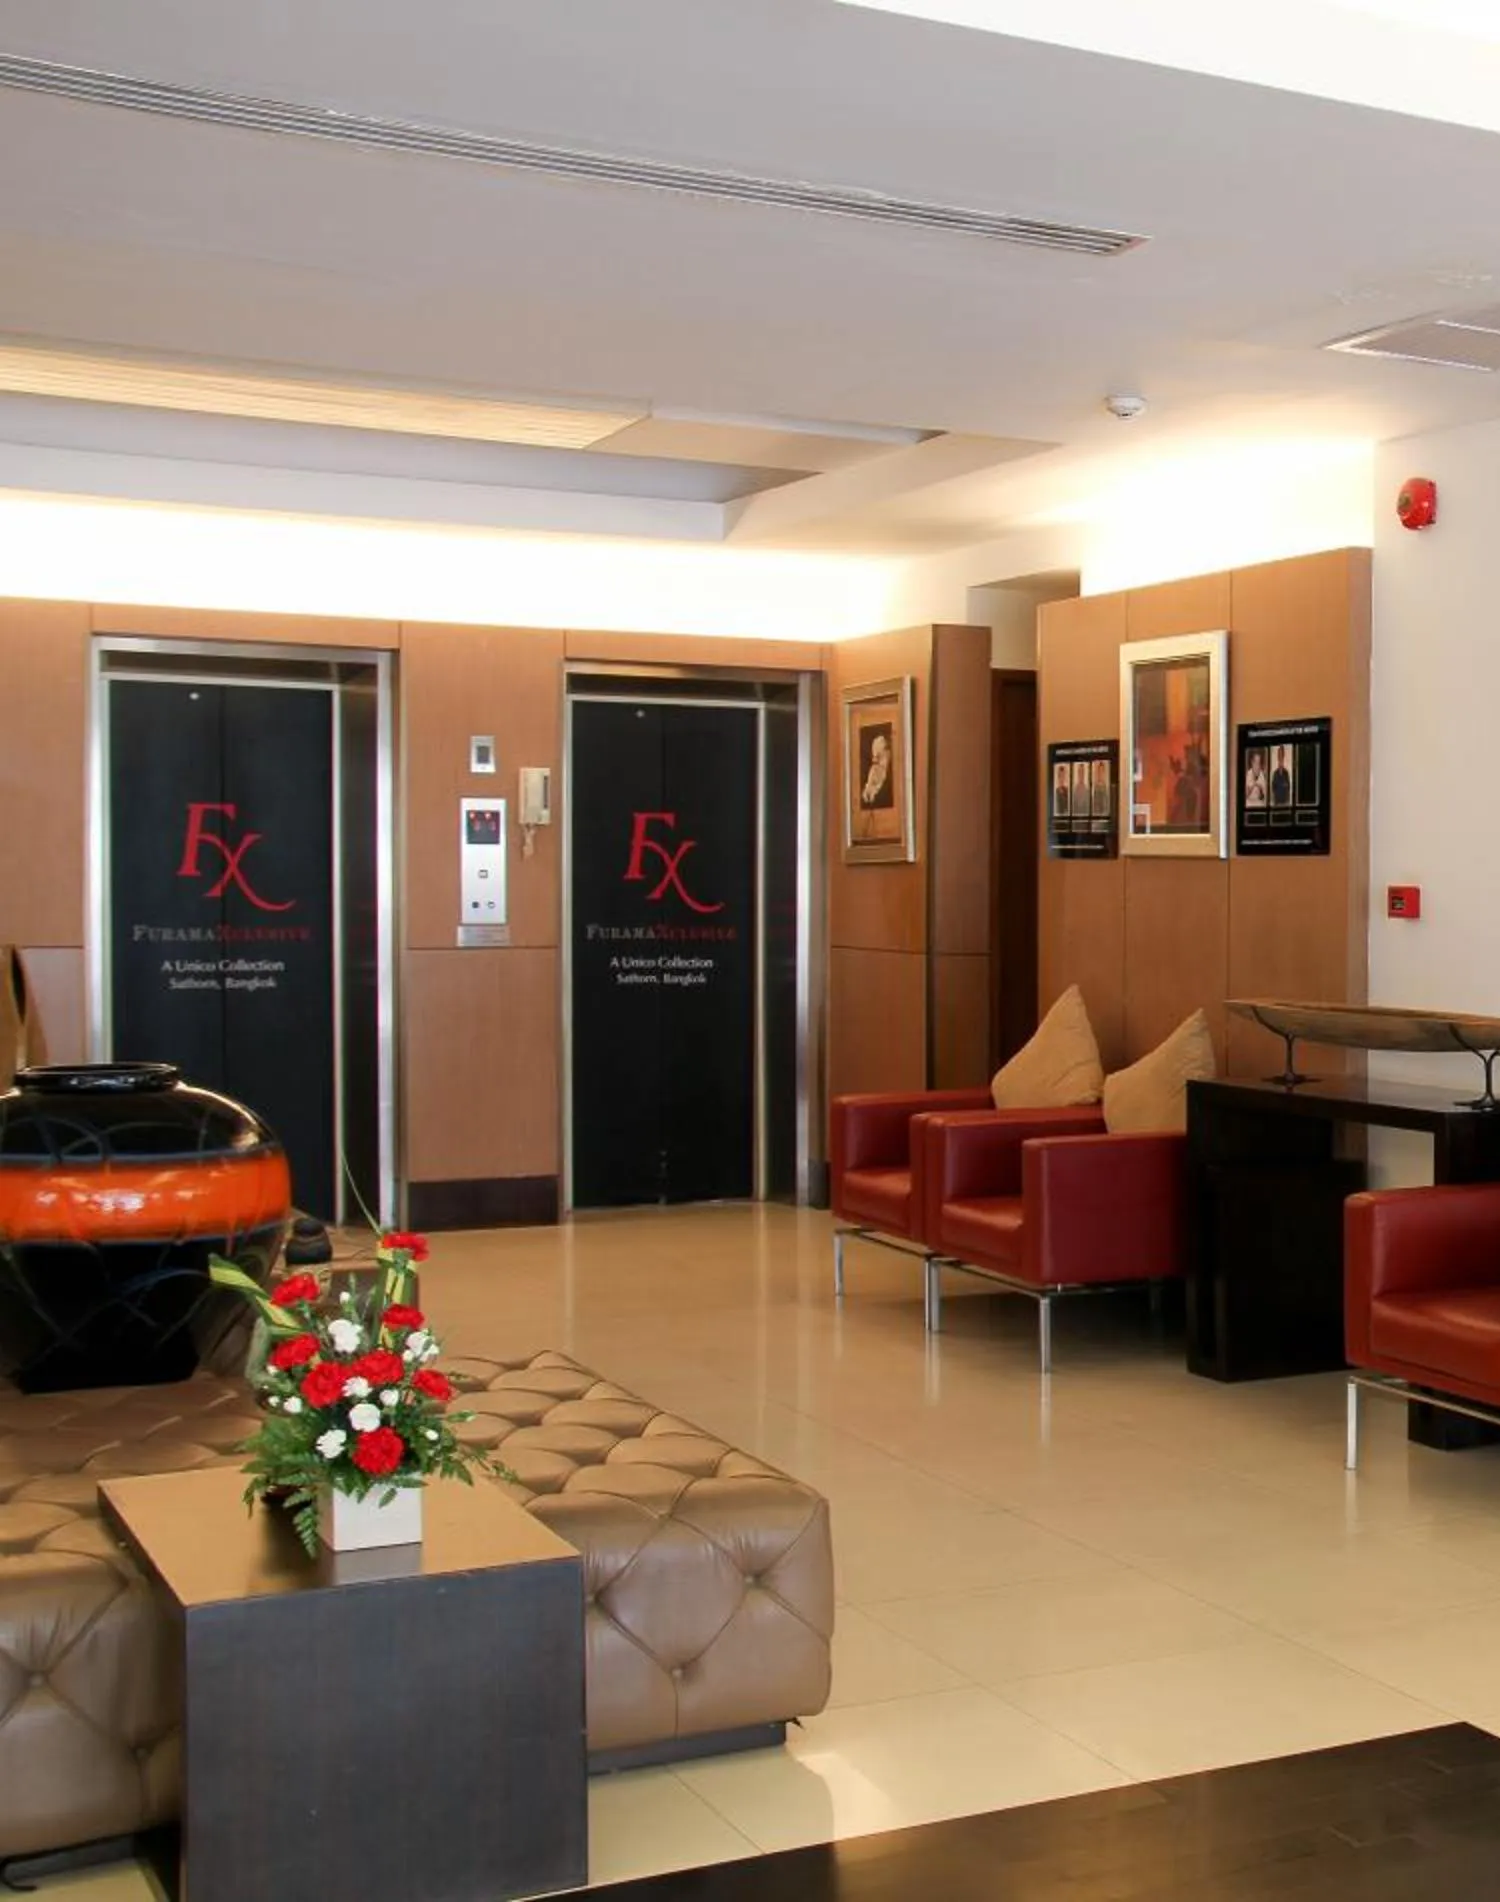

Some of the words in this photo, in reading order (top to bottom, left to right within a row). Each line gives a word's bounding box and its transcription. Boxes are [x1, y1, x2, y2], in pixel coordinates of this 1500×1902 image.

[161, 960, 173, 972] A
[176, 960, 216, 973] Unico
[218, 959, 285, 972] Collection
[610, 957, 619, 968] A
[622, 957, 656, 969] Unico
[658, 956, 713, 968] Collection
[225, 977, 277, 991] Bangkok
[663, 973, 706, 986] Bangkok
